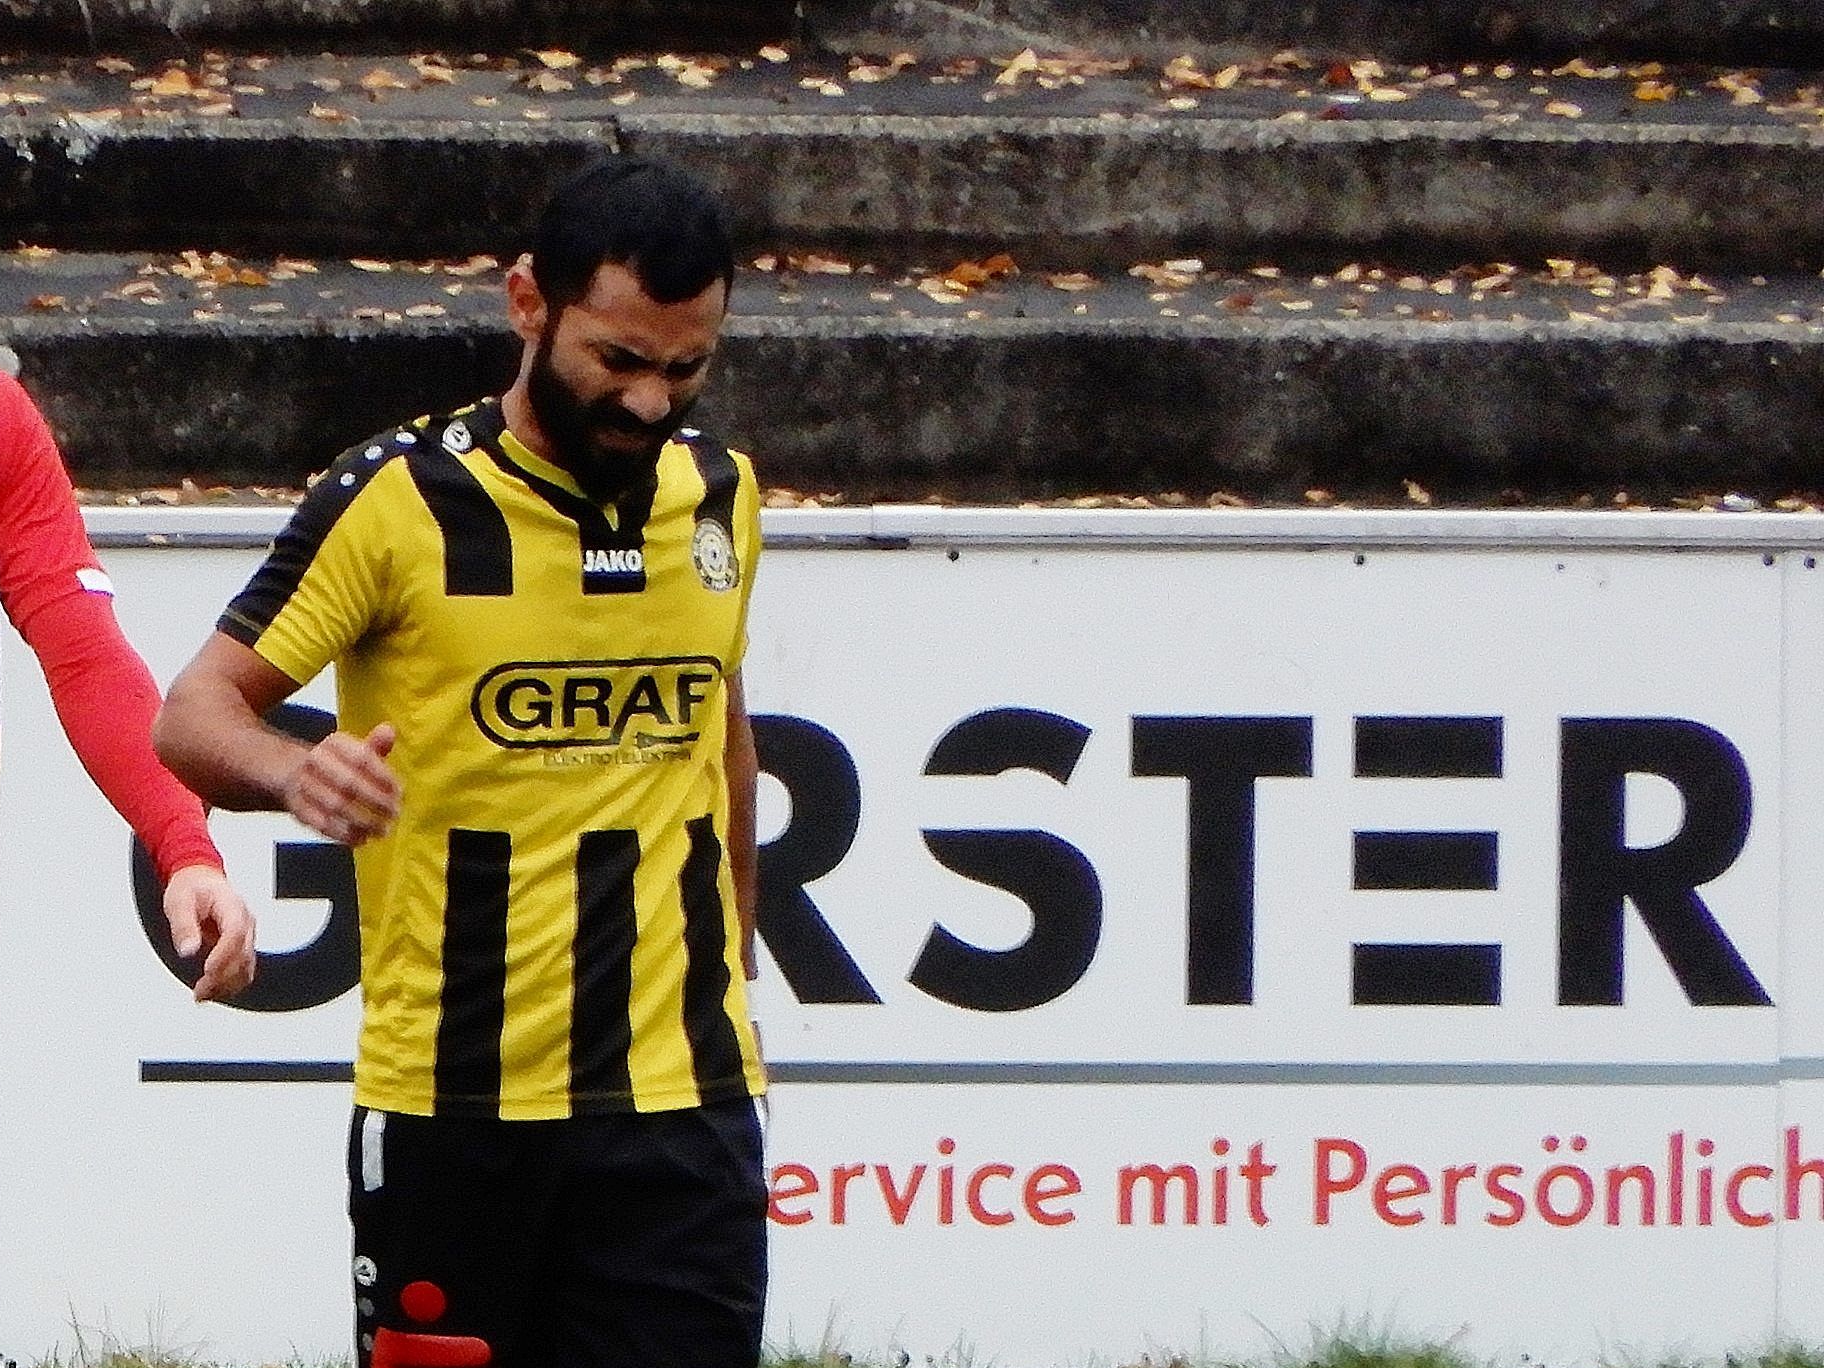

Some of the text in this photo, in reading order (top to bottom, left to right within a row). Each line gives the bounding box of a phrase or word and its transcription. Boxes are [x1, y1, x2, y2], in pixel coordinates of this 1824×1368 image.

[584, 549, 644, 572] JAKO
[494, 674, 713, 742] GRAF
[129, 704, 1777, 1013] GRSTER
[1117, 1137, 1278, 1226] mit
[1313, 1127, 1824, 1228] Persönlich
